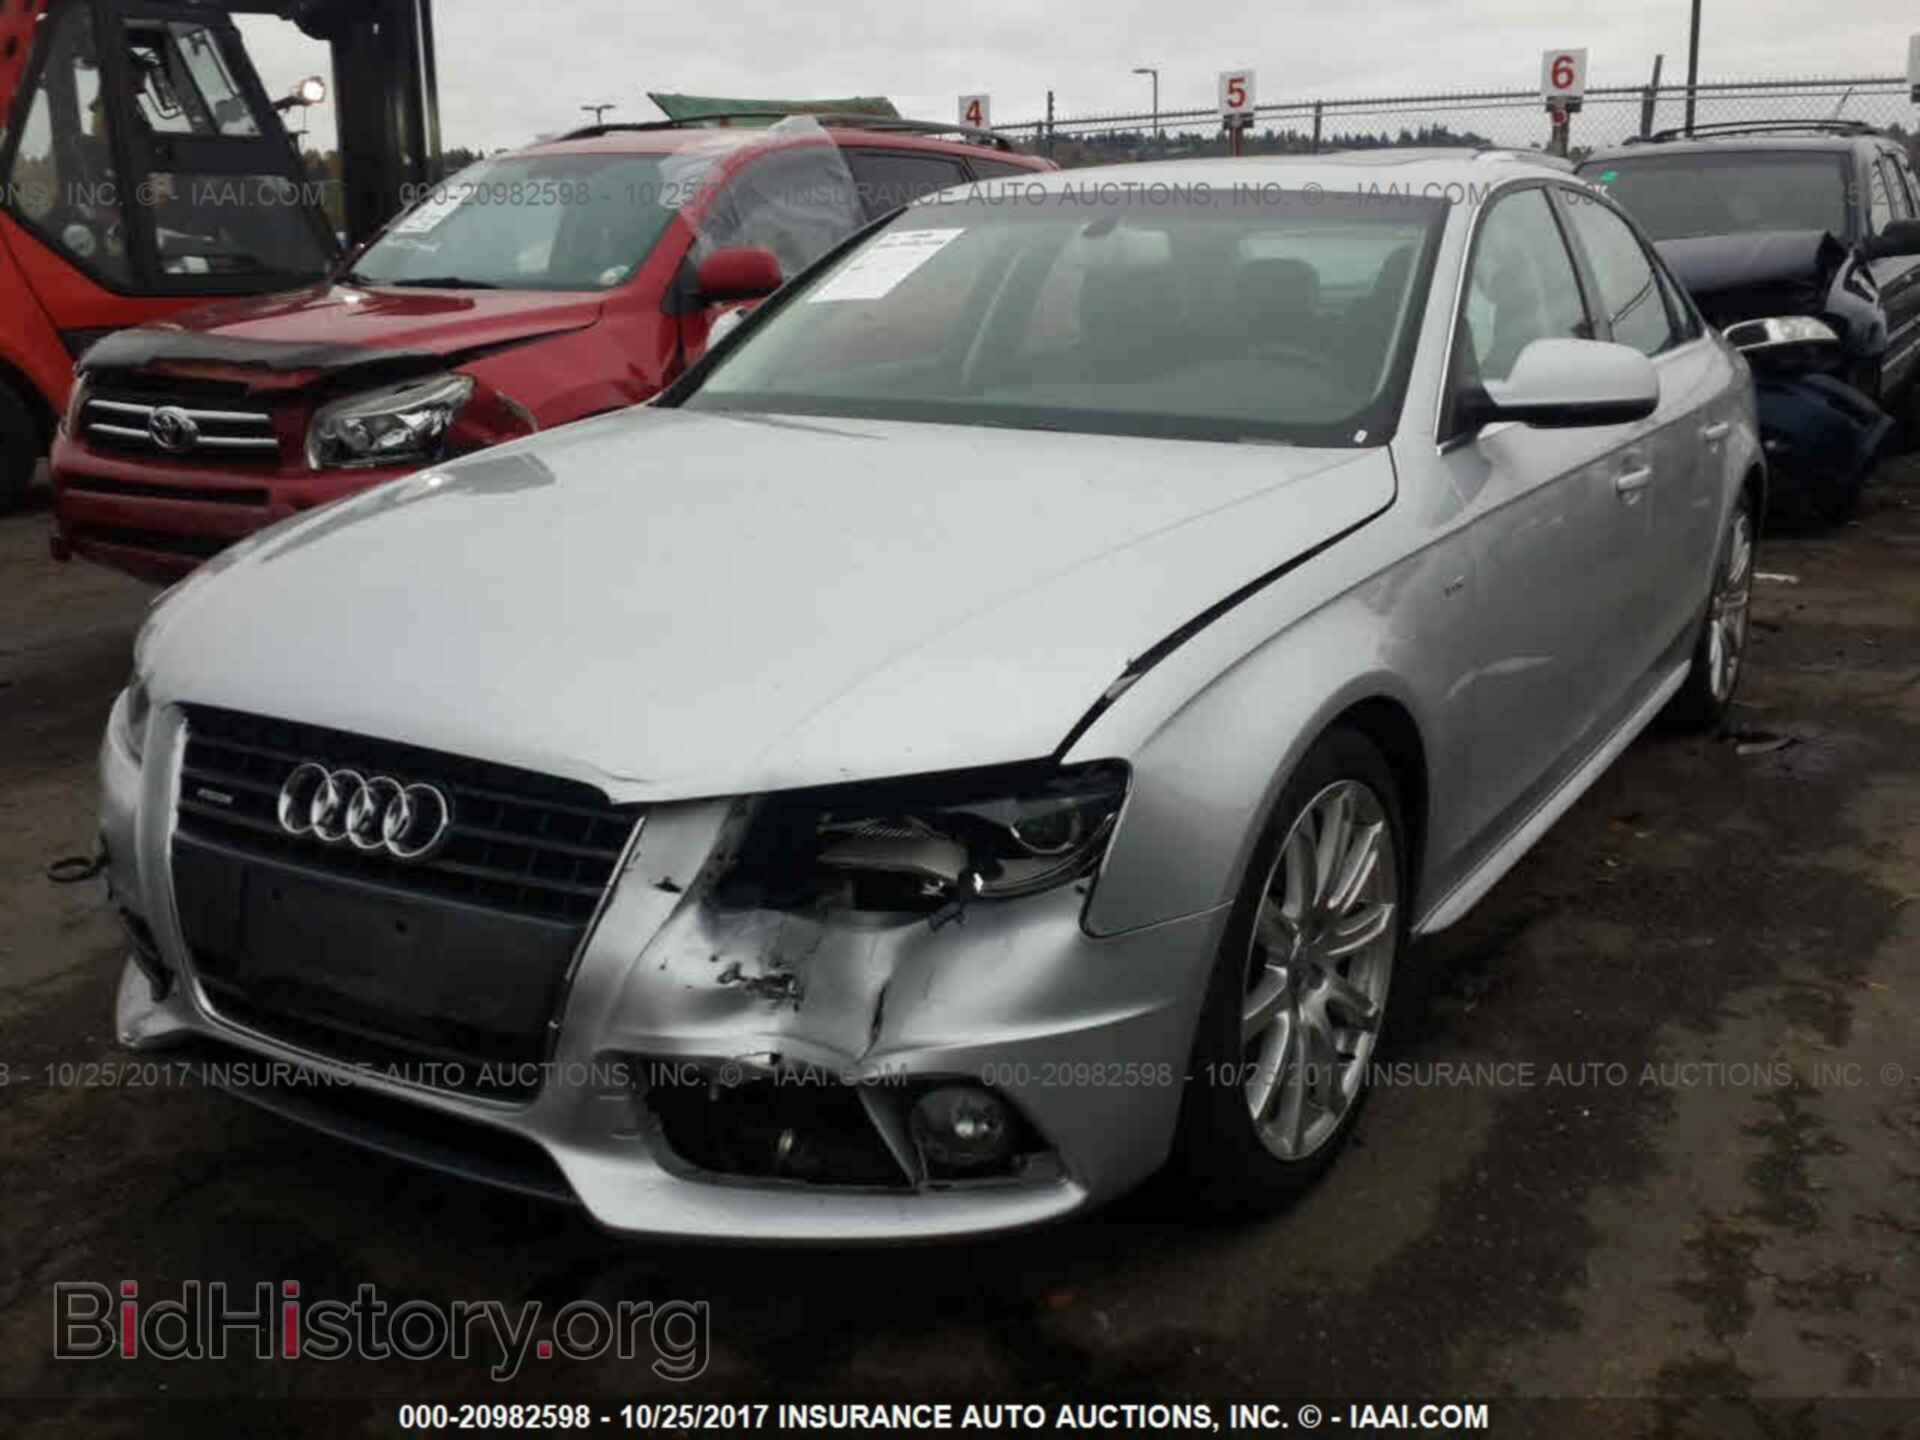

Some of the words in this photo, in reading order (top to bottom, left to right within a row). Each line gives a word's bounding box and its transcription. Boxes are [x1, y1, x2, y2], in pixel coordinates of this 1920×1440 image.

[1551, 55, 1574, 89] 6
[1227, 77, 1247, 108] 5
[966, 99, 983, 128] 4
